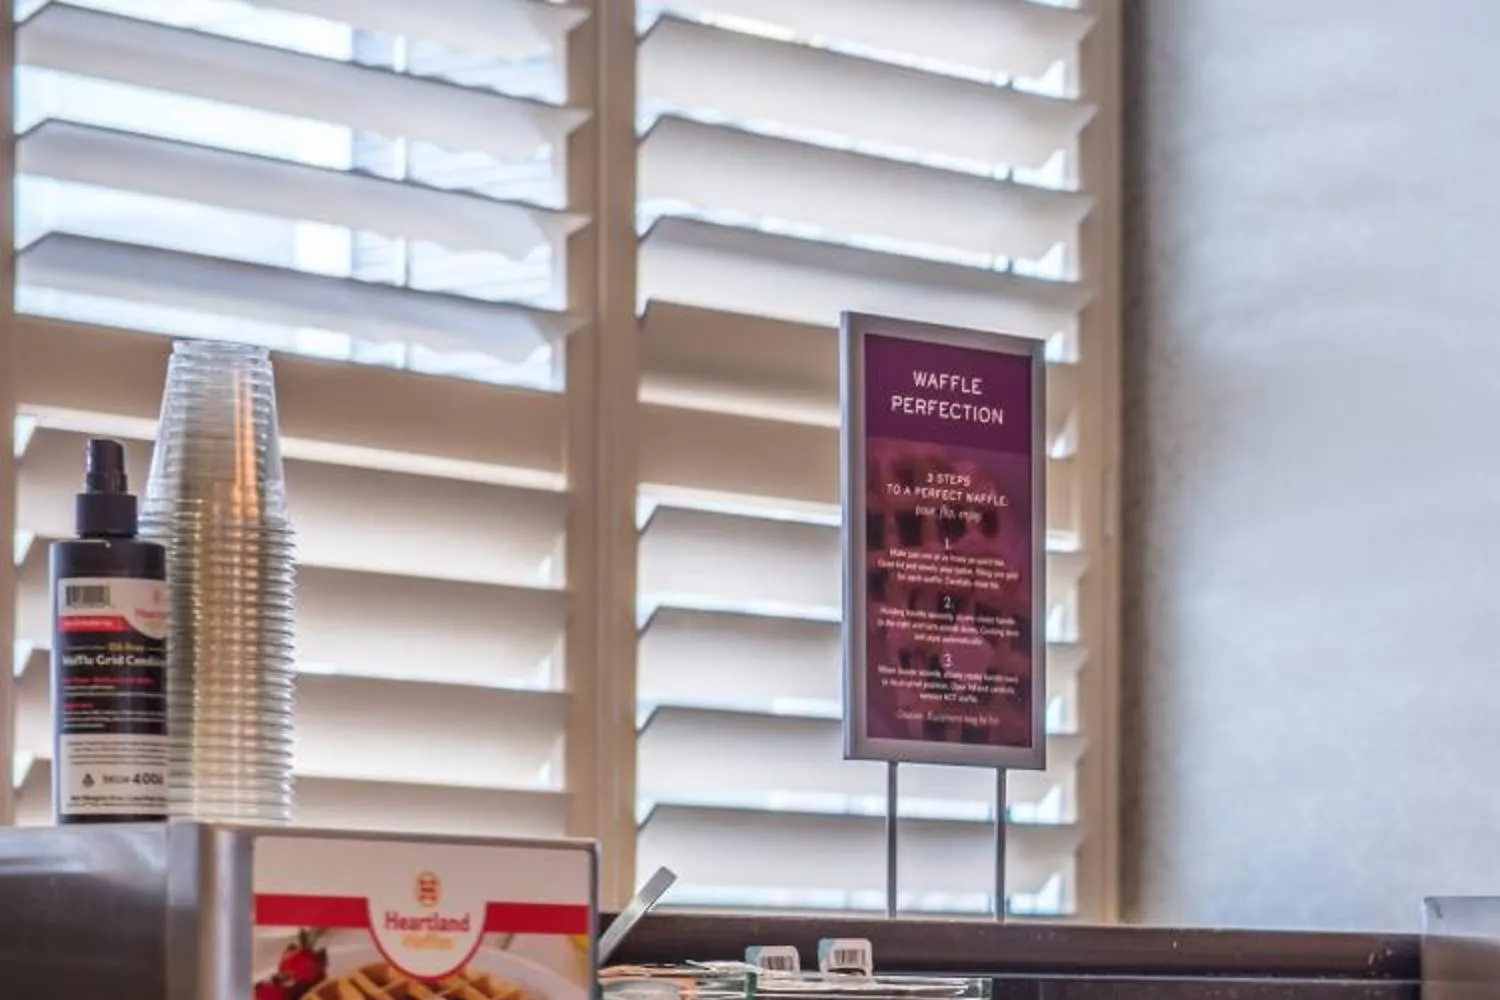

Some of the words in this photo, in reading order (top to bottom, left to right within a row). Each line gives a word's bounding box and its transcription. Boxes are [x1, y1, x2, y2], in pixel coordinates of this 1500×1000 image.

[913, 370, 983, 395] WAFFLE
[891, 395, 1004, 424] PERFECTION
[937, 473, 971, 487] STEPS
[886, 483, 901, 495] TO
[914, 486, 962, 501] PERFECT
[385, 911, 471, 933] Heartland
